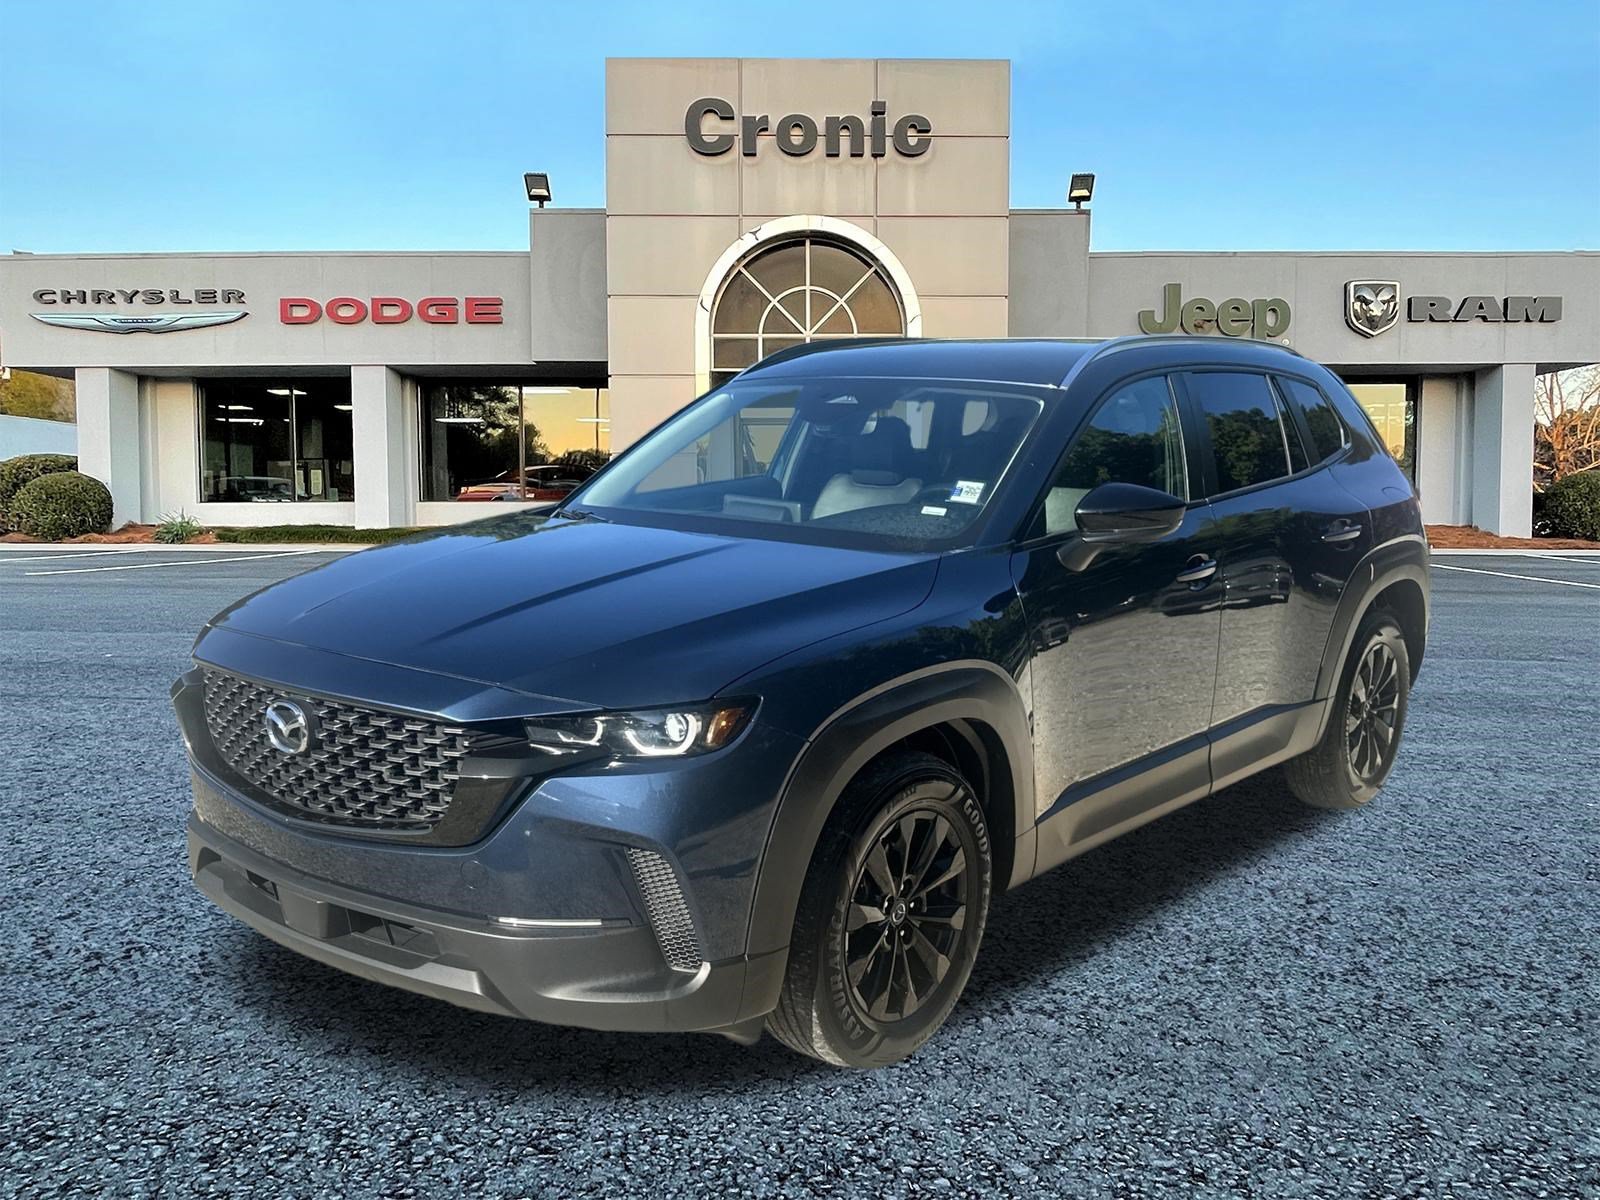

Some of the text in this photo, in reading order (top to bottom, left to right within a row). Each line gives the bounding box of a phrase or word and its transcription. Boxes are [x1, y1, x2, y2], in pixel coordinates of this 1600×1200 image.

[684, 97, 933, 157] Cronic
[32, 288, 247, 305] CHRYSLER
[280, 296, 504, 325] DODGE
[1408, 295, 1563, 323] RAM
[1138, 283, 1292, 340] Jeep
